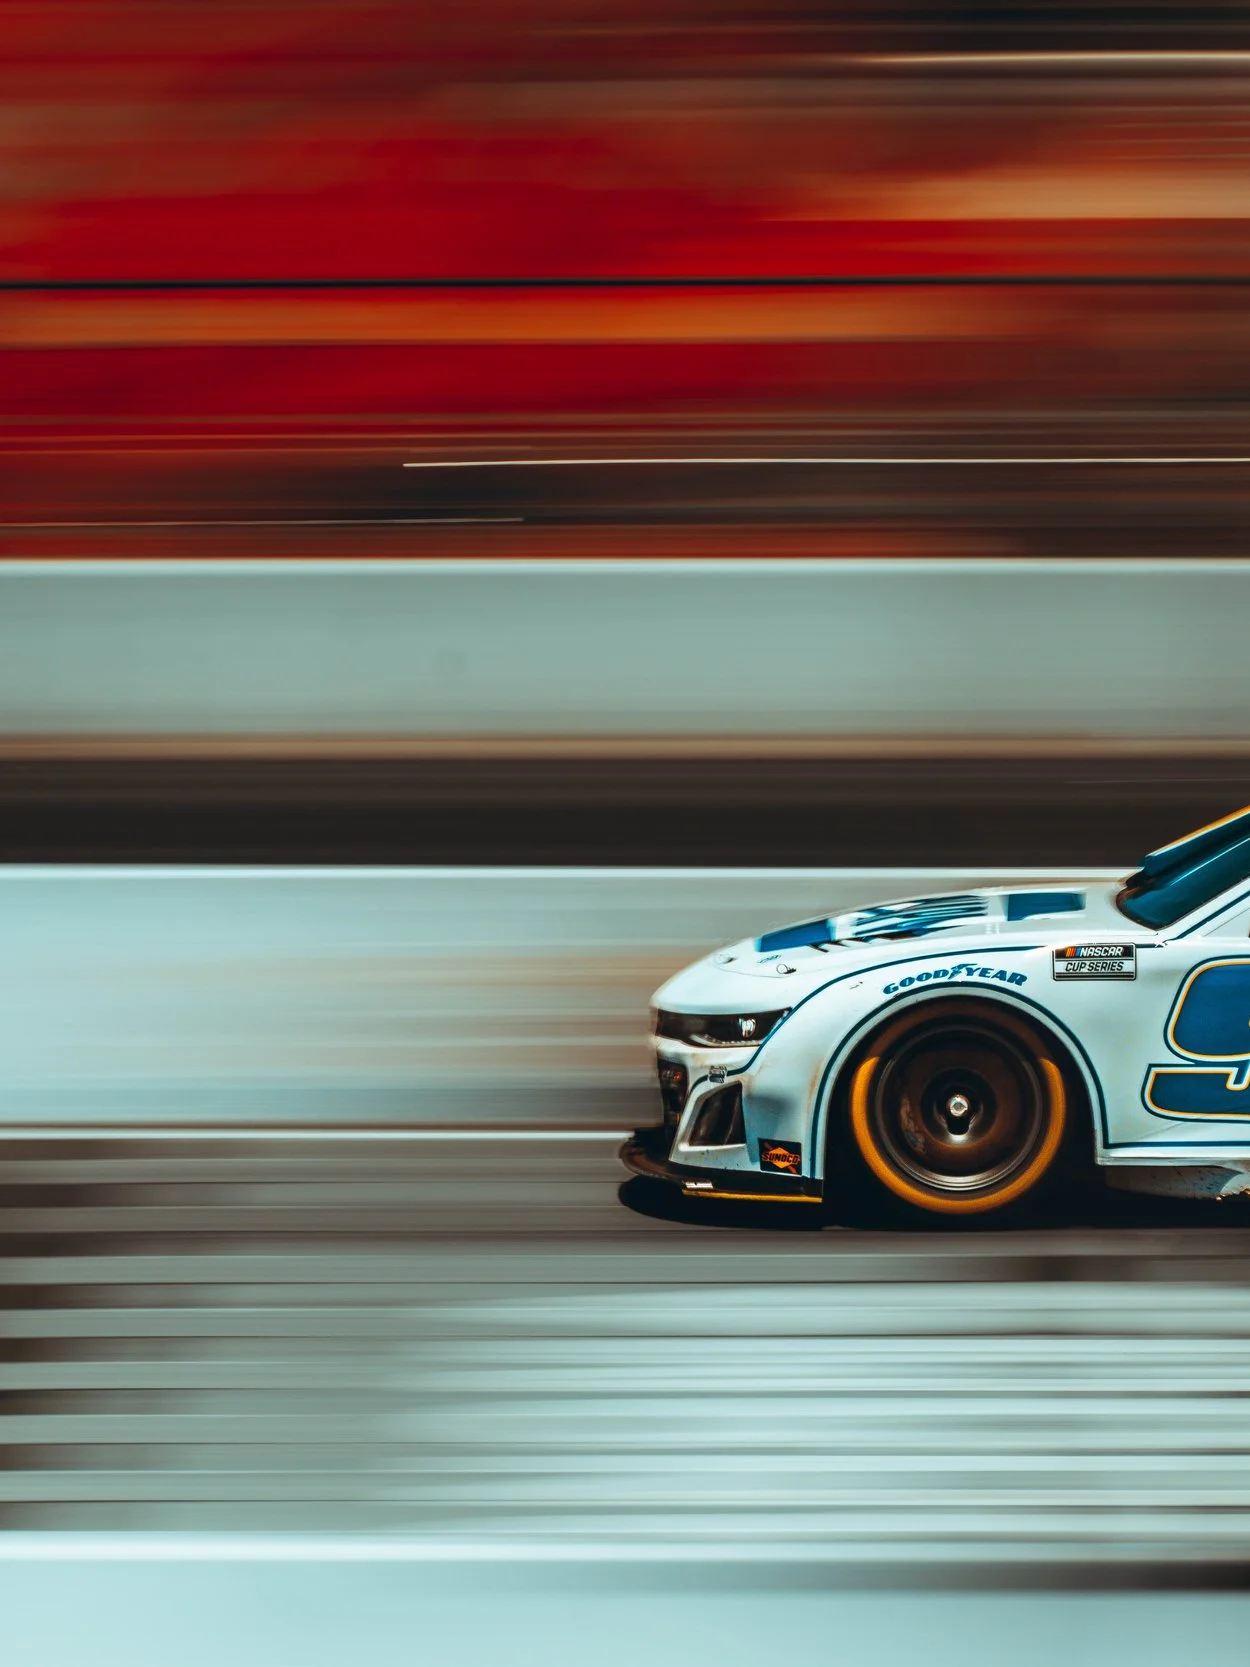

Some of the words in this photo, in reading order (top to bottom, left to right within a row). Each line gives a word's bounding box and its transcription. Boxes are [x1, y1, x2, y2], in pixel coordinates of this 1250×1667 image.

[1079, 946, 1124, 958] NASCAR
[1065, 962, 1087, 972] CUP
[1087, 961, 1124, 972] SERIES
[883, 963, 1028, 995] GOODYEAR
[762, 1152, 800, 1165] SUNOCO
